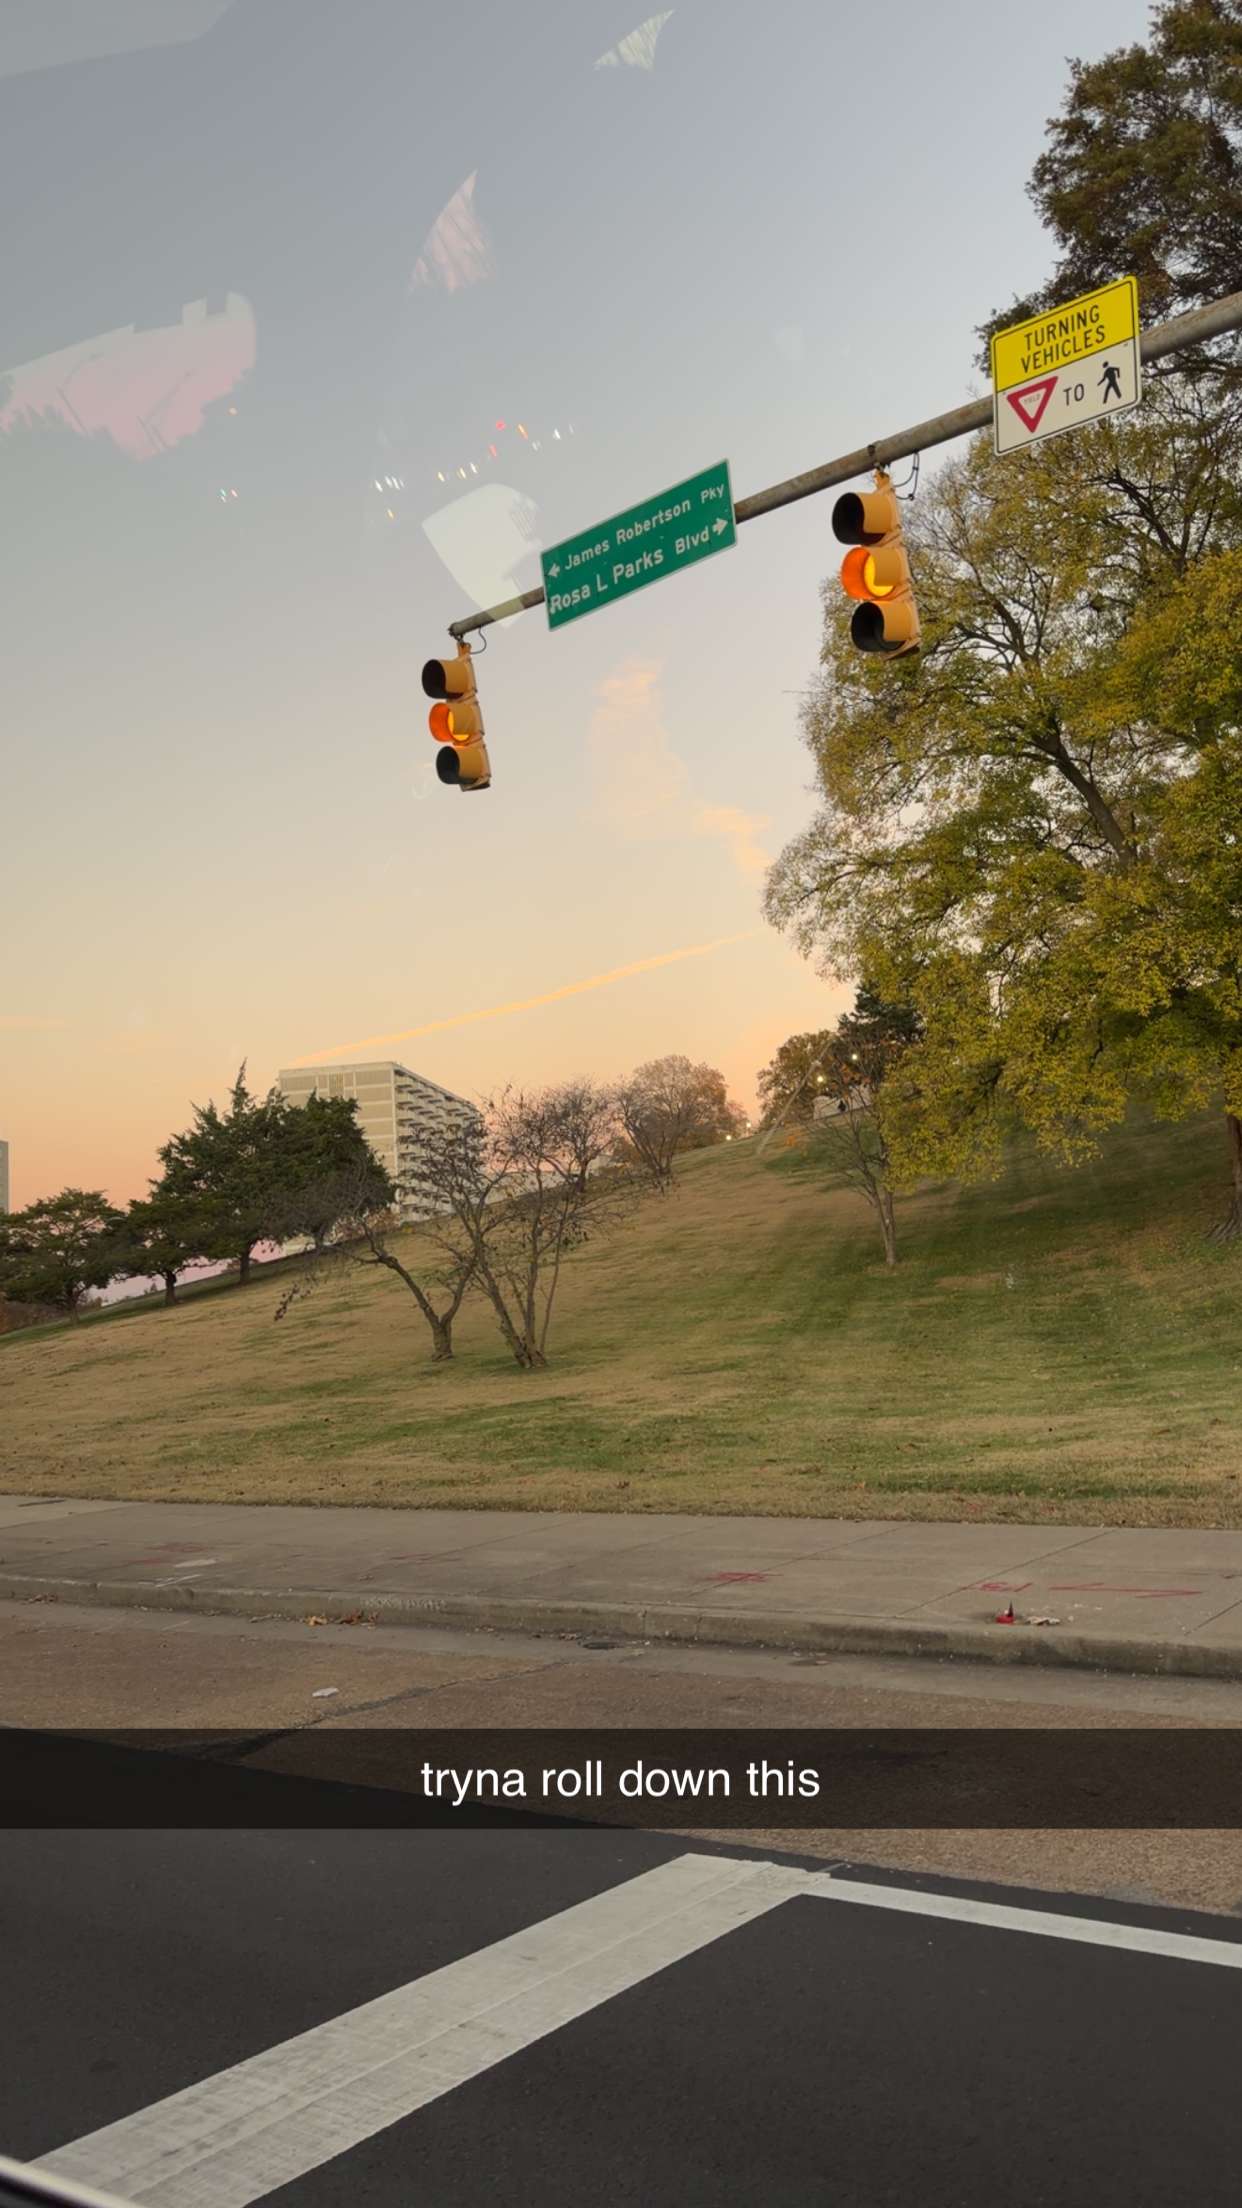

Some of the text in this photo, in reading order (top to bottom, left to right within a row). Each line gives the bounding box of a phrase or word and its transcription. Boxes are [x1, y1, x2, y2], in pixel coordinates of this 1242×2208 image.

[1021, 325, 1106, 374] VEHICLES
[1024, 305, 1100, 351] TURNING
[1063, 383, 1085, 407] TO
[564, 484, 725, 571] James Robertson Pky
[550, 527, 710, 614] Rosa L Parks Blvd
